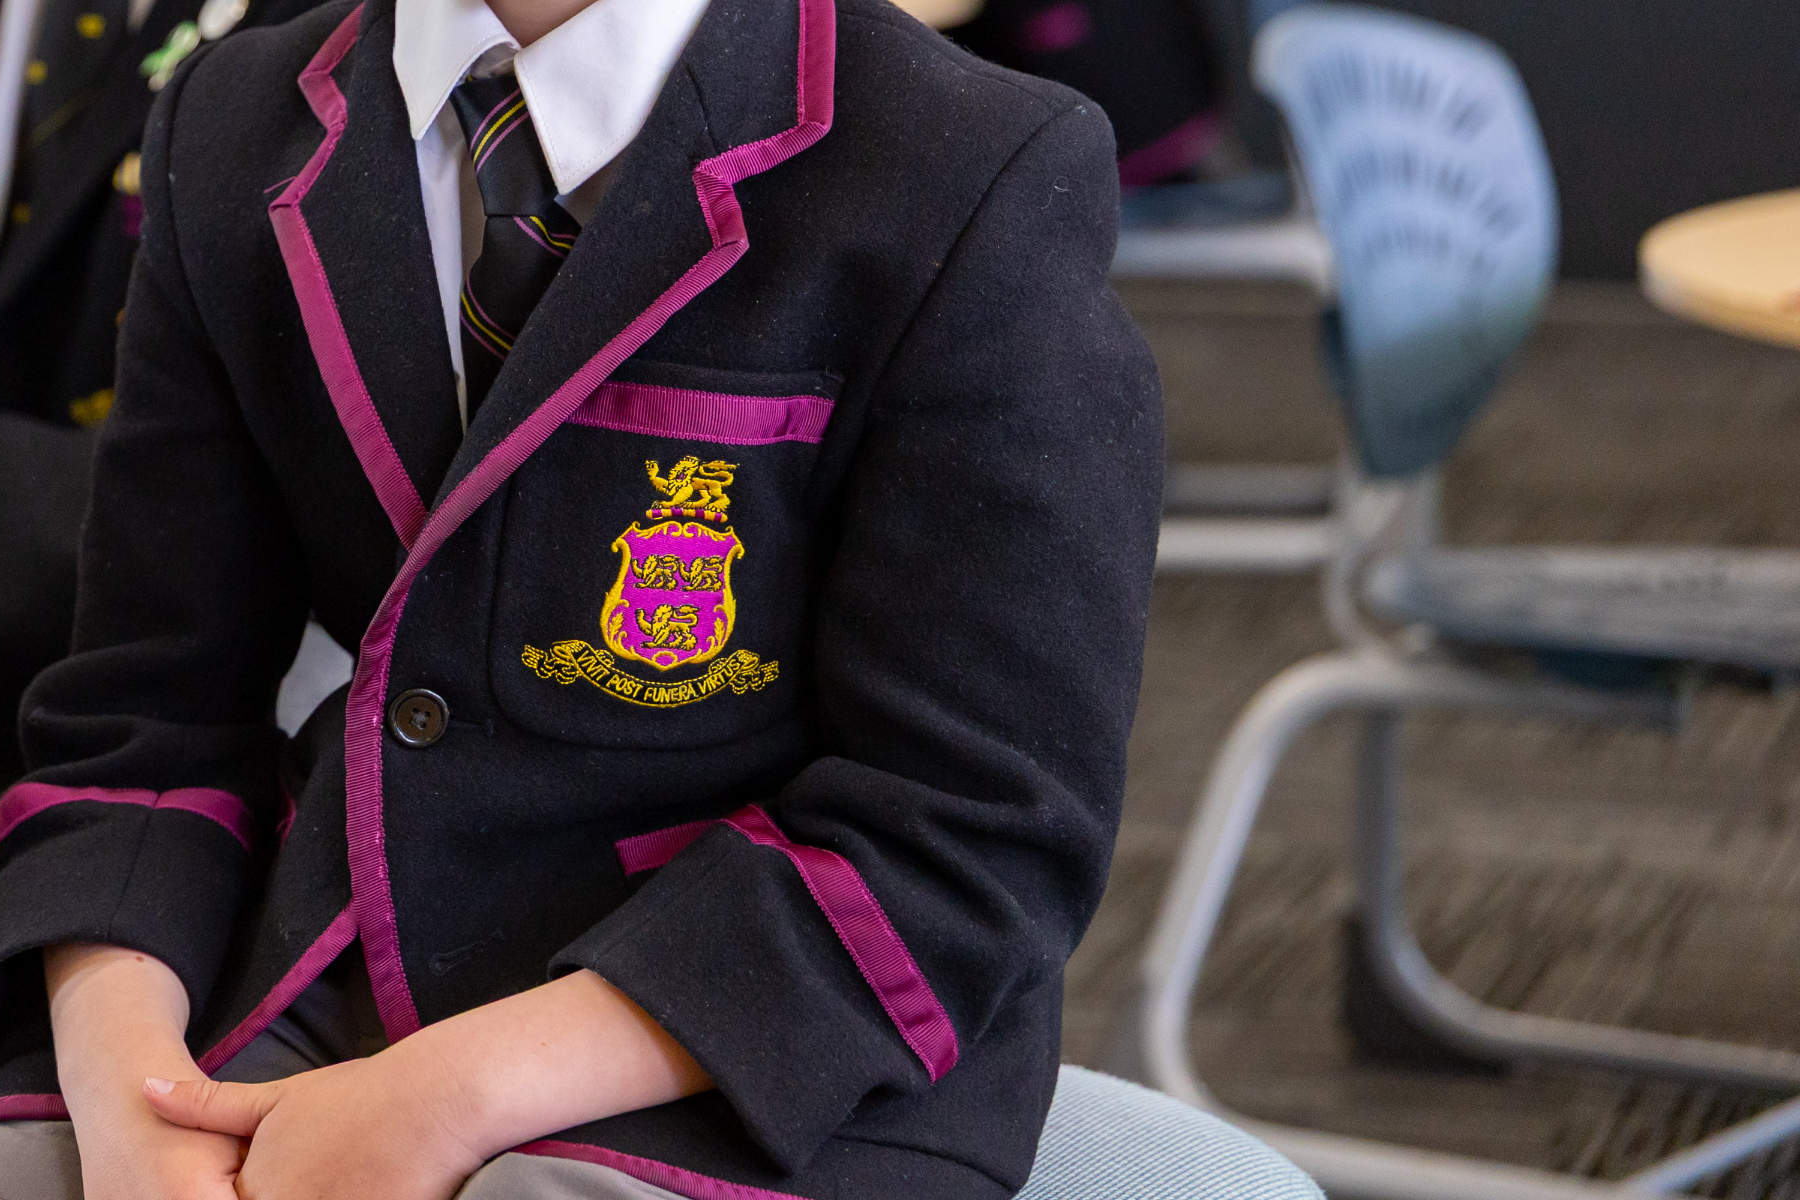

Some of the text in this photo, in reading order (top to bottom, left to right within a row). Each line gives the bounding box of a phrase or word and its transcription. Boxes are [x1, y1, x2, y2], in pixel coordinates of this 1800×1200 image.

[605, 674, 643, 697] POST
[643, 685, 699, 704] FUNERA
[697, 658, 741, 695] VIRTUS
